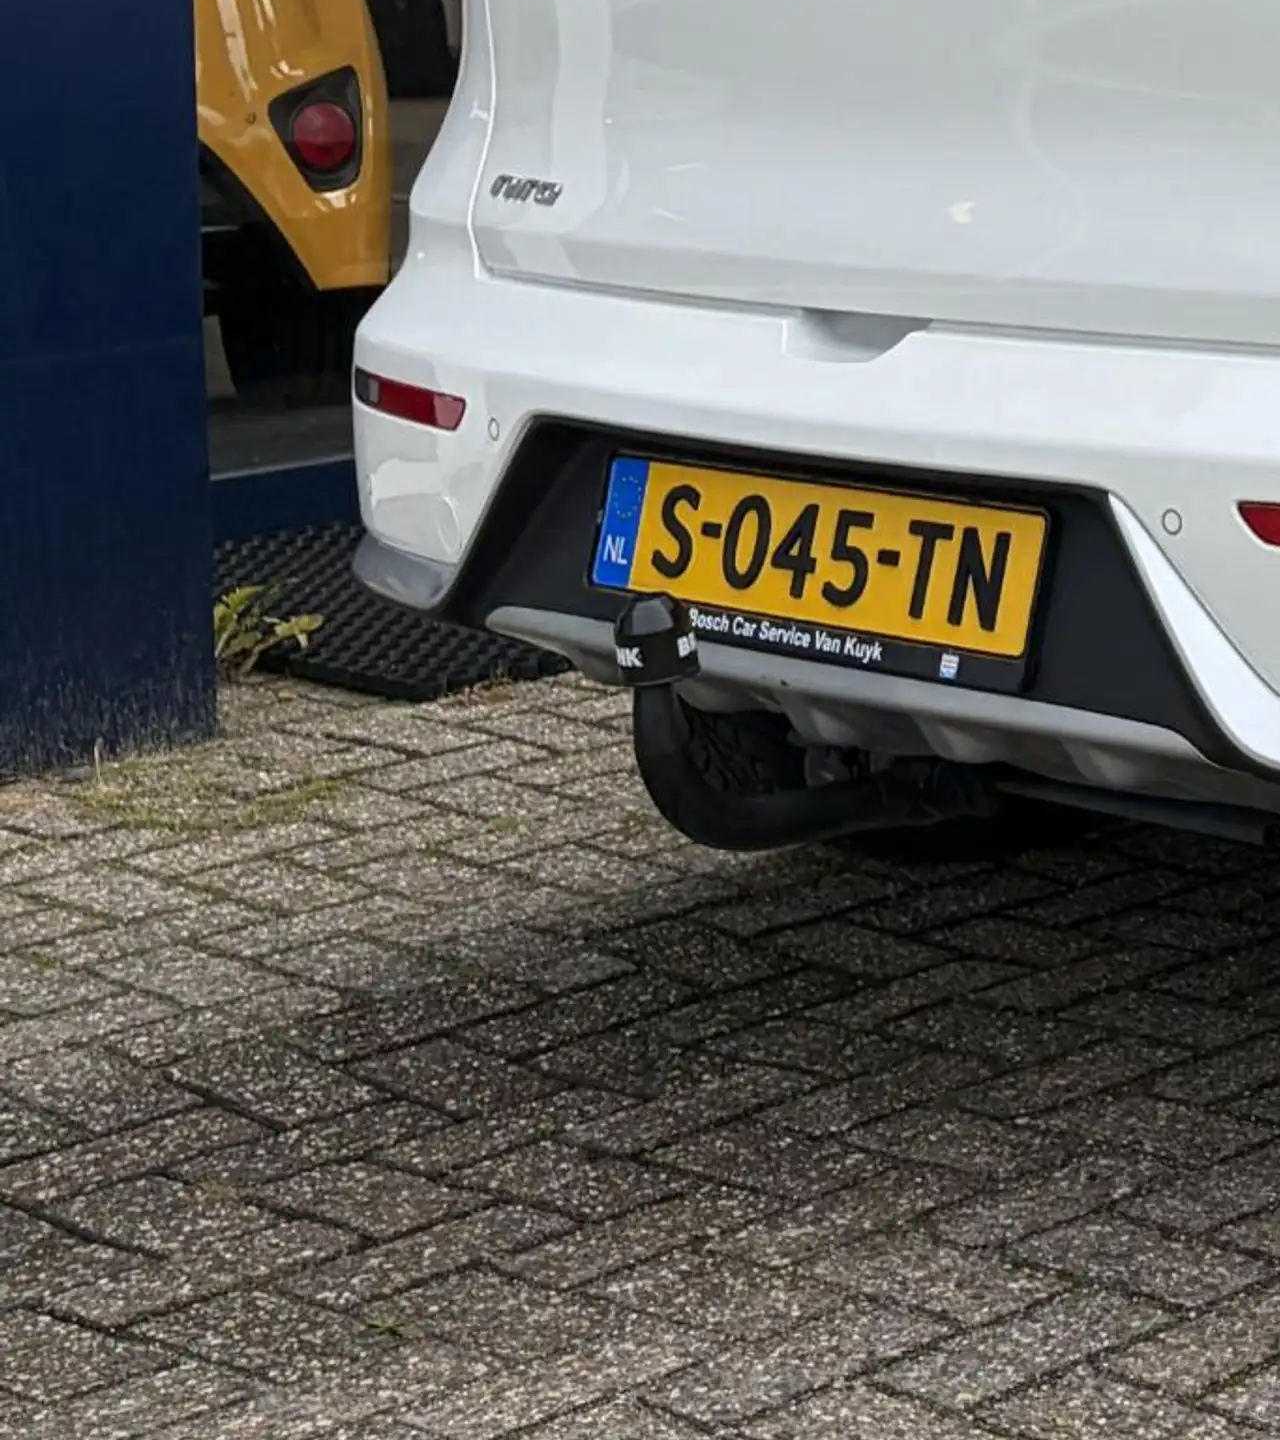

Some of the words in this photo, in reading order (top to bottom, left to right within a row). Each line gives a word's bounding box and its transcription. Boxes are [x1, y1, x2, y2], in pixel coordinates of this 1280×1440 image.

[602, 534, 628, 566] NL
[650, 483, 1012, 632] S-045-TN
[732, 616, 757, 638] Car
[759, 620, 811, 649] Service
[815, 629, 841, 655] Van
[843, 634, 883, 664] Kuyk
